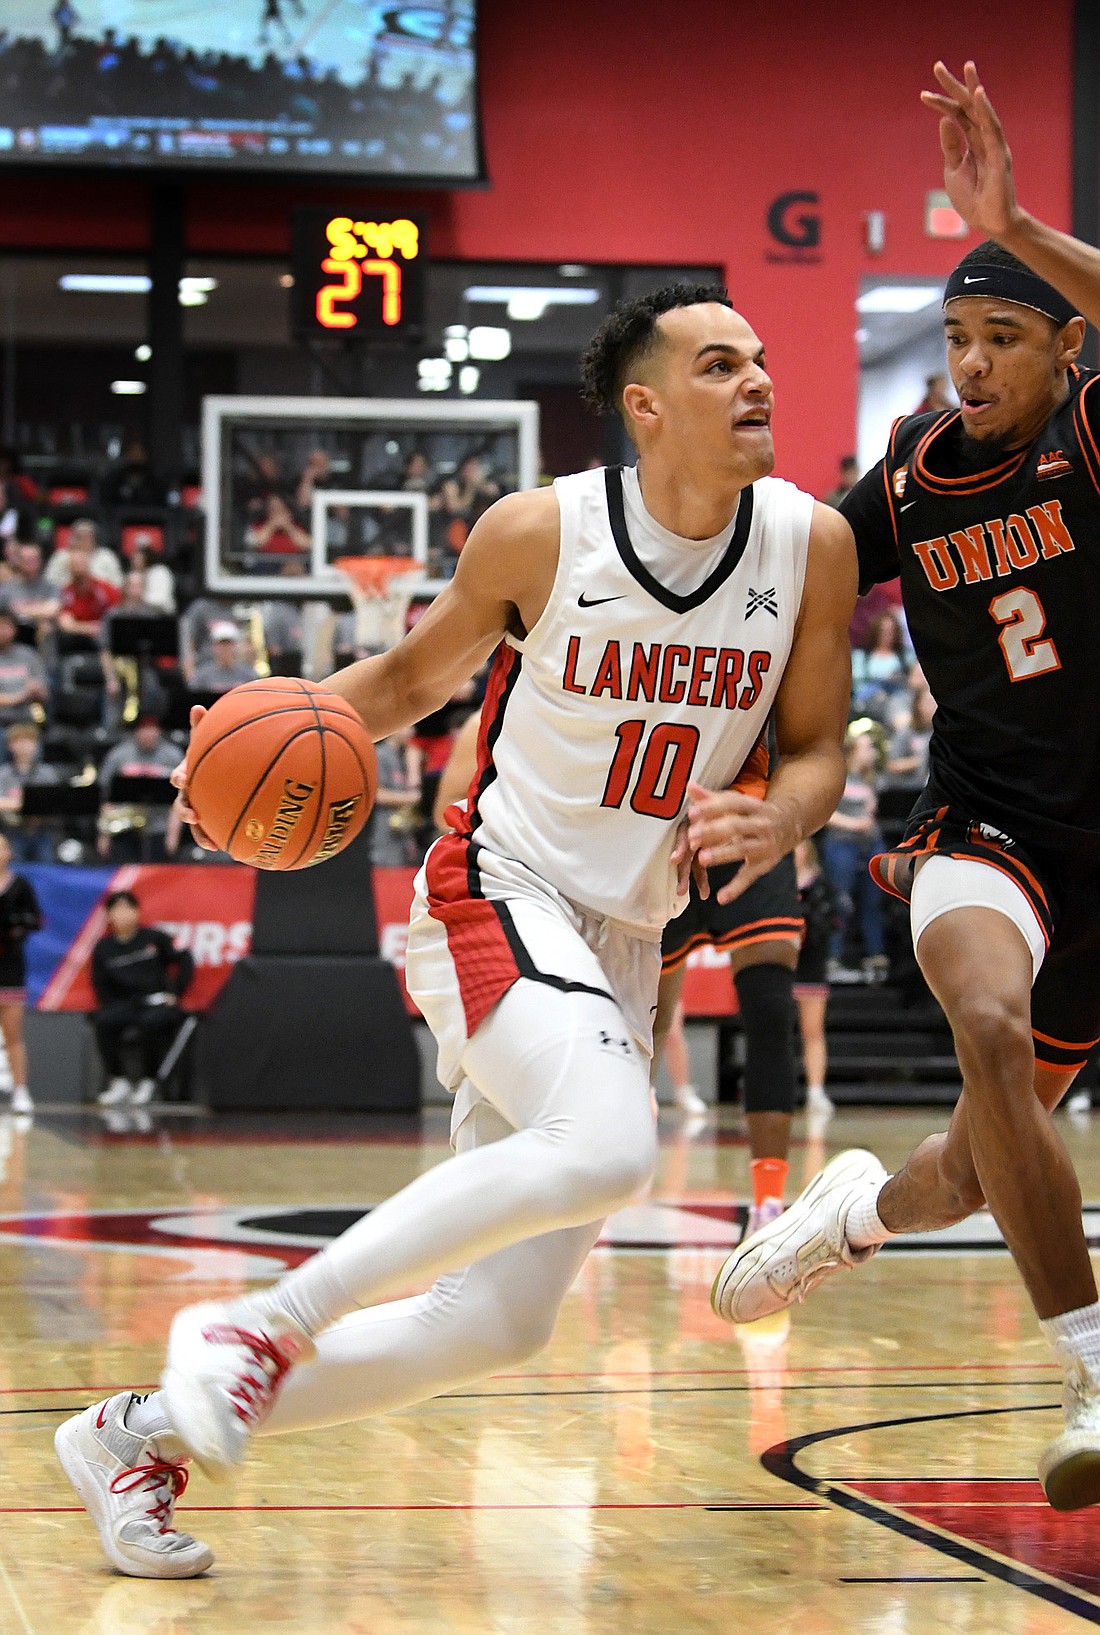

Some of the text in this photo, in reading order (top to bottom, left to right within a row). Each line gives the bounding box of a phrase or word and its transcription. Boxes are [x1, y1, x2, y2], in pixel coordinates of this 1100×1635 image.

[767, 190, 820, 248] G
[315, 258, 402, 328] 27
[1038, 450, 1065, 465] AAC
[911, 499, 1075, 592] UNION
[988, 586, 1062, 683] 2
[562, 635, 772, 711] LANCERS
[600, 719, 701, 821] 10
